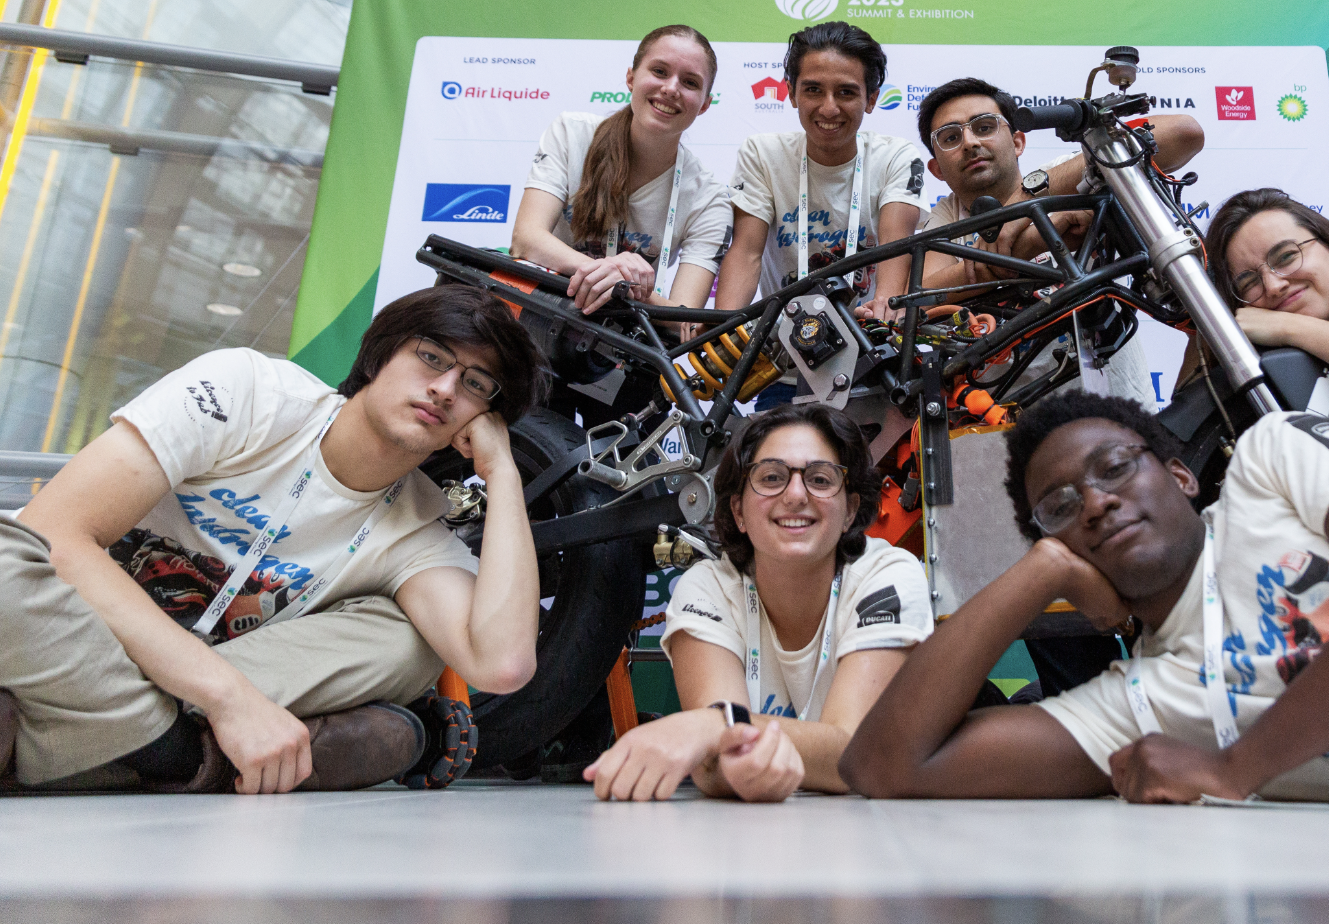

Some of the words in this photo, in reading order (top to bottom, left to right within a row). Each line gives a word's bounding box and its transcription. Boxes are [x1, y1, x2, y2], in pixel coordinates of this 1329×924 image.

[847, 9, 893, 18] SUMMIT
[896, 9, 905, 18] &
[909, 9, 974, 19] EXHIBITION
[463, 56, 488, 64] LEAD
[491, 57, 536, 65] SPONSOR
[465, 87, 487, 98] Air
[490, 87, 551, 101] Liquide
[1293, 83, 1307, 92] bp
[1012, 95, 1066, 107] Deloitt
[453, 205, 504, 220] Linde
[292, 478, 308, 499] sec
[388, 480, 403, 499] sec
[253, 535, 272, 557] sec
[353, 527, 370, 547] sec
[307, 578, 327, 596] sec
[211, 594, 231, 617] sec
[749, 592, 758, 614] sec
[865, 614, 891, 623] DUCATI
[750, 657, 759, 680] sec
